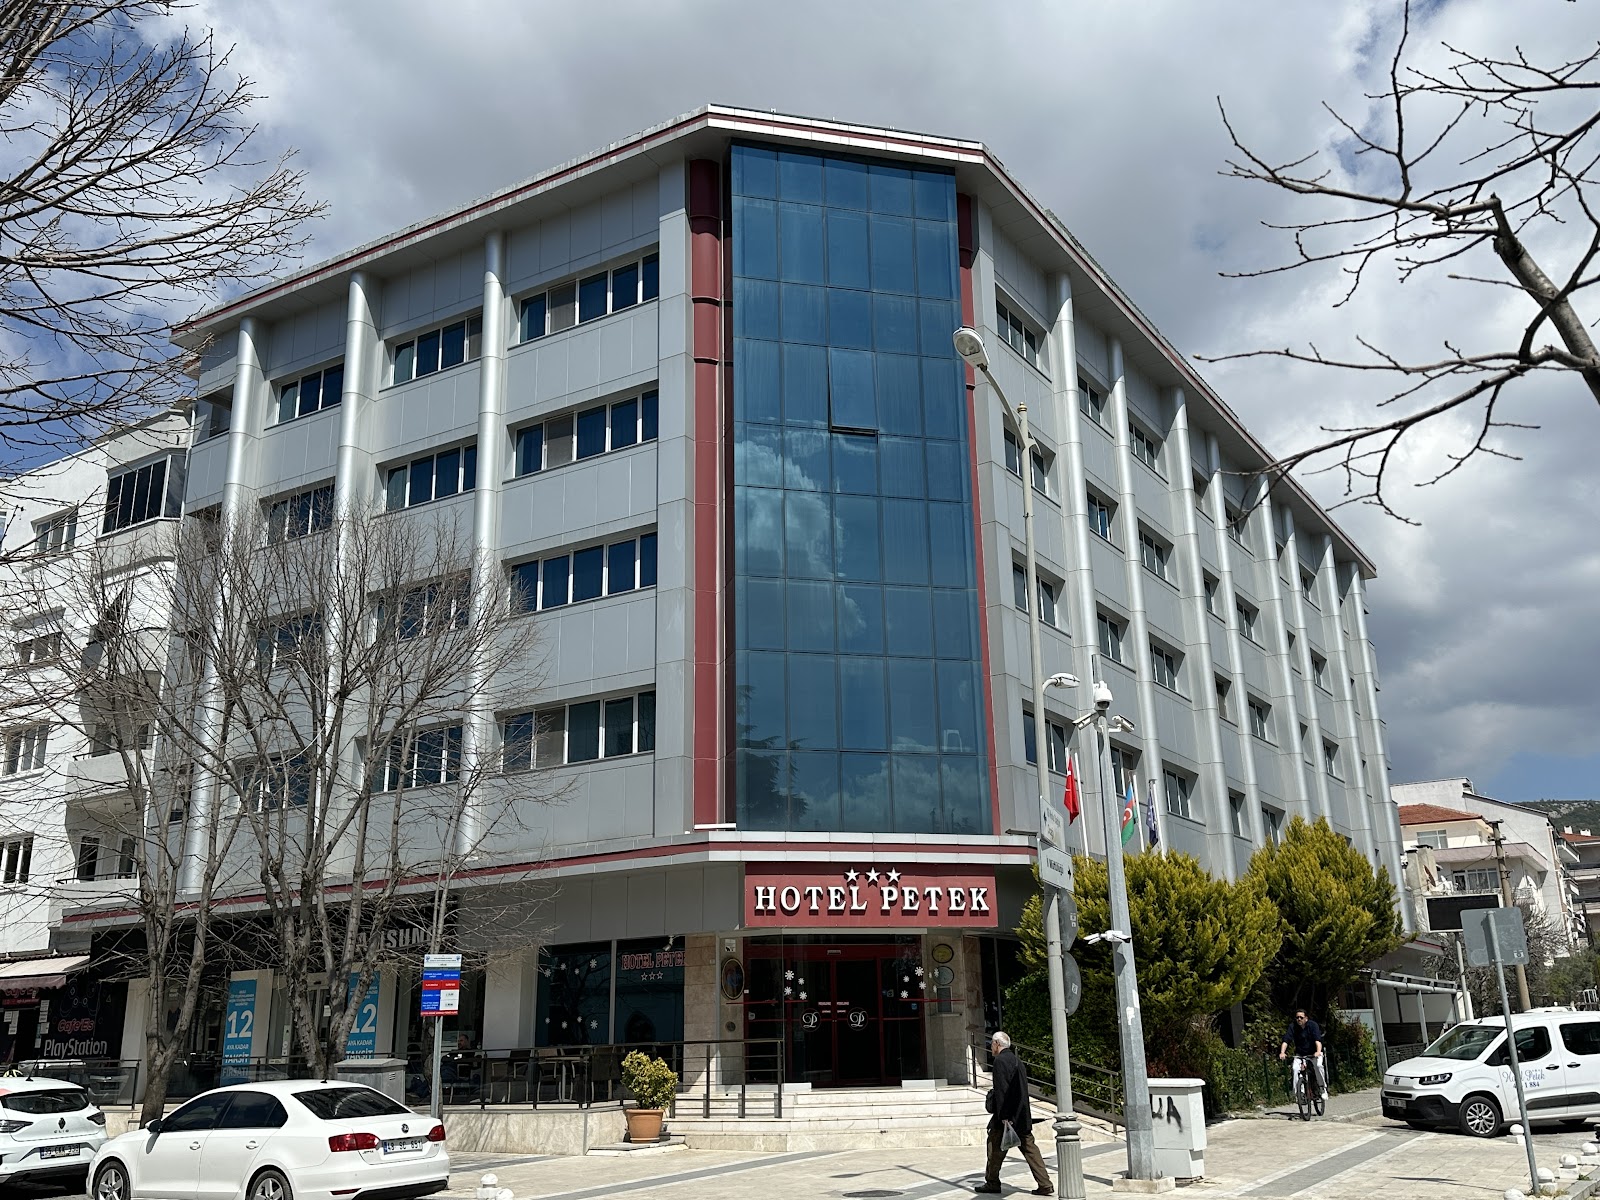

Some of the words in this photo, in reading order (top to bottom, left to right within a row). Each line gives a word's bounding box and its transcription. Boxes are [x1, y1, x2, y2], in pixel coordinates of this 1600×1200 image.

[755, 886, 867, 911] HOTEL
[880, 886, 990, 912] PETEK
[621, 953, 655, 970] HOTEL
[227, 1009, 253, 1038] 12
[43, 1037, 108, 1060] PlayStation
